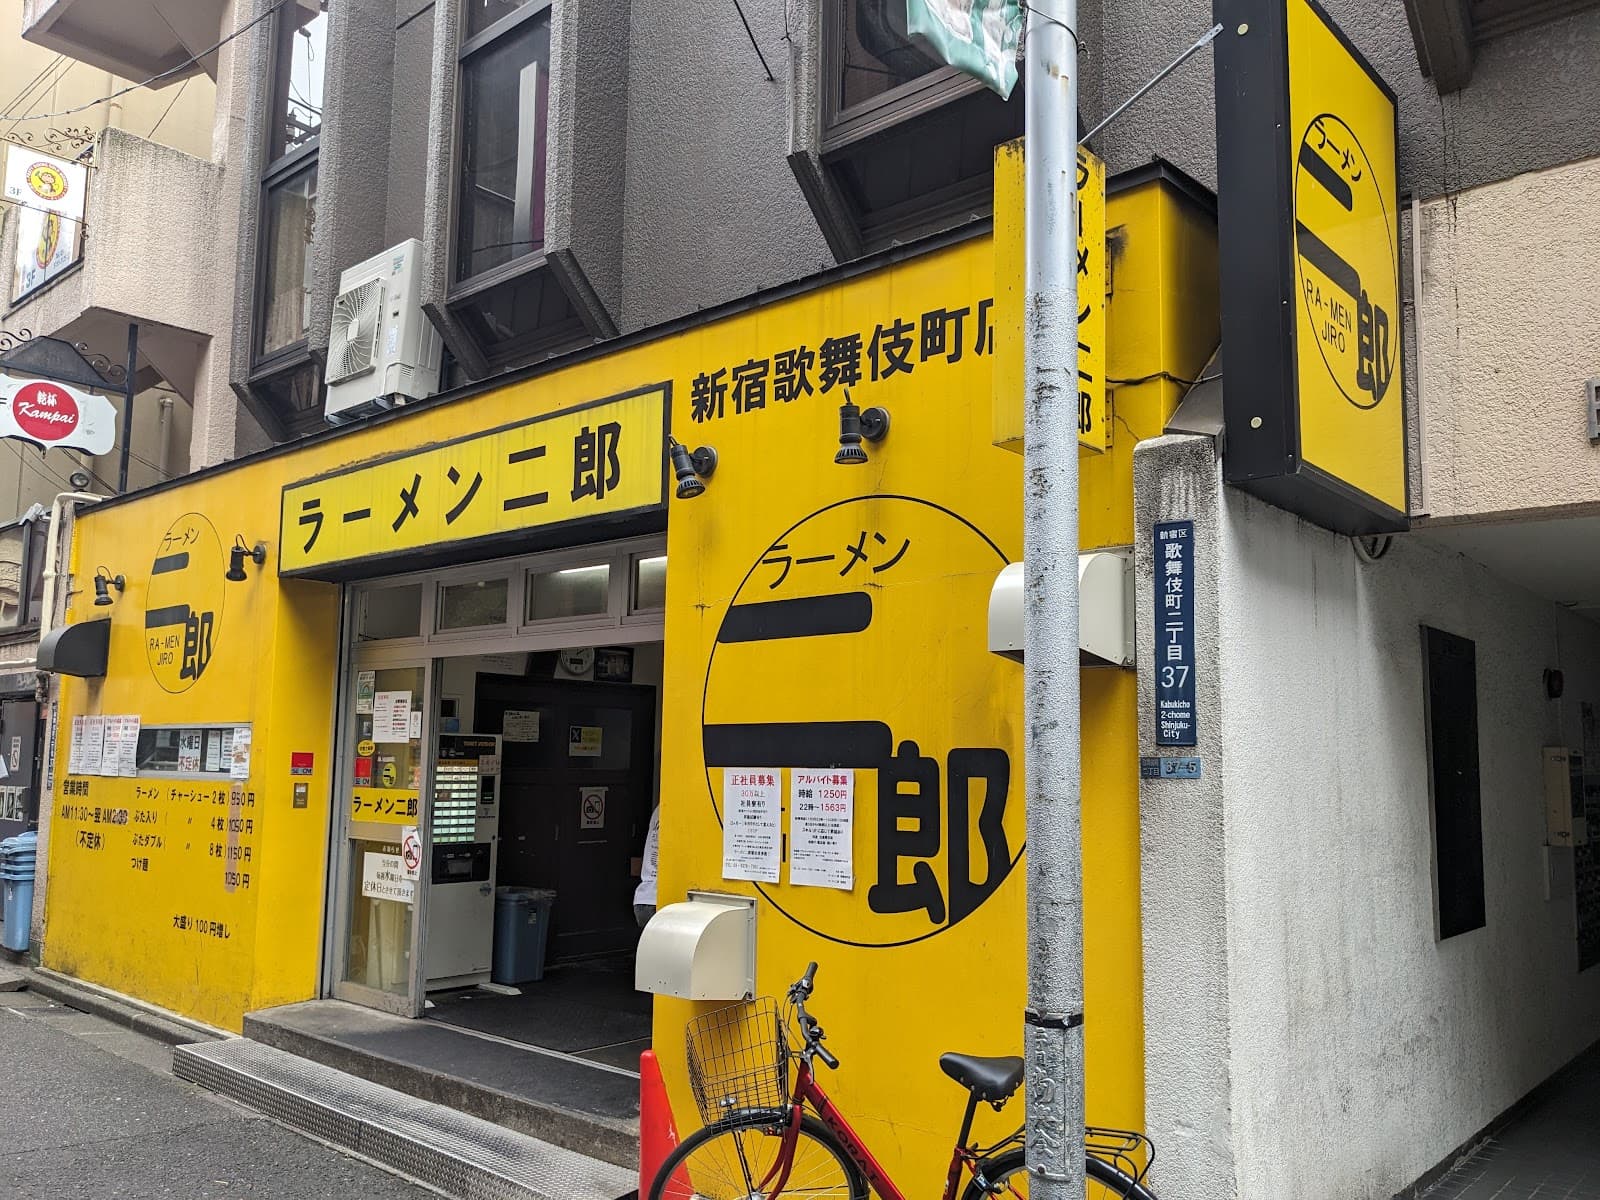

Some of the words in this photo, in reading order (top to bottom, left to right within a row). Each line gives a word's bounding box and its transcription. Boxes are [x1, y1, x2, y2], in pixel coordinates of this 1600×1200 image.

[1314, 118, 1362, 182] ラーメン
[1305, 277, 1352, 333] RA-MEN
[1321, 319, 1346, 354] JIRO
[18, 402, 76, 424] Kampai
[298, 421, 622, 555] ラーメン二郎
[164, 528, 200, 552] ラーメン
[762, 531, 910, 590] ラーメン
[1164, 542, 1184, 662] 歌舞伎町二丁目
[149, 635, 181, 650] RA-MEN
[156, 651, 174, 666] JIRO
[1160, 664, 1190, 689] 37
[1160, 700, 1191, 709] Kabukicho
[1160, 710, 1191, 719] 2-chome
[180, 735, 201, 750] 水曜日
[1163, 729, 1181, 740] City
[63, 779, 89, 797] 営業時間
[731, 774, 775, 787] 正社員募集
[797, 774, 848, 786] アルバイト募集
[135, 786, 160, 800] ラーメン
[798, 789, 813, 799] 時給
[818, 789, 847, 800] 1250円
[353, 796, 418, 818] ラーメン二郎
[134, 810, 158, 825] ぶた入り
